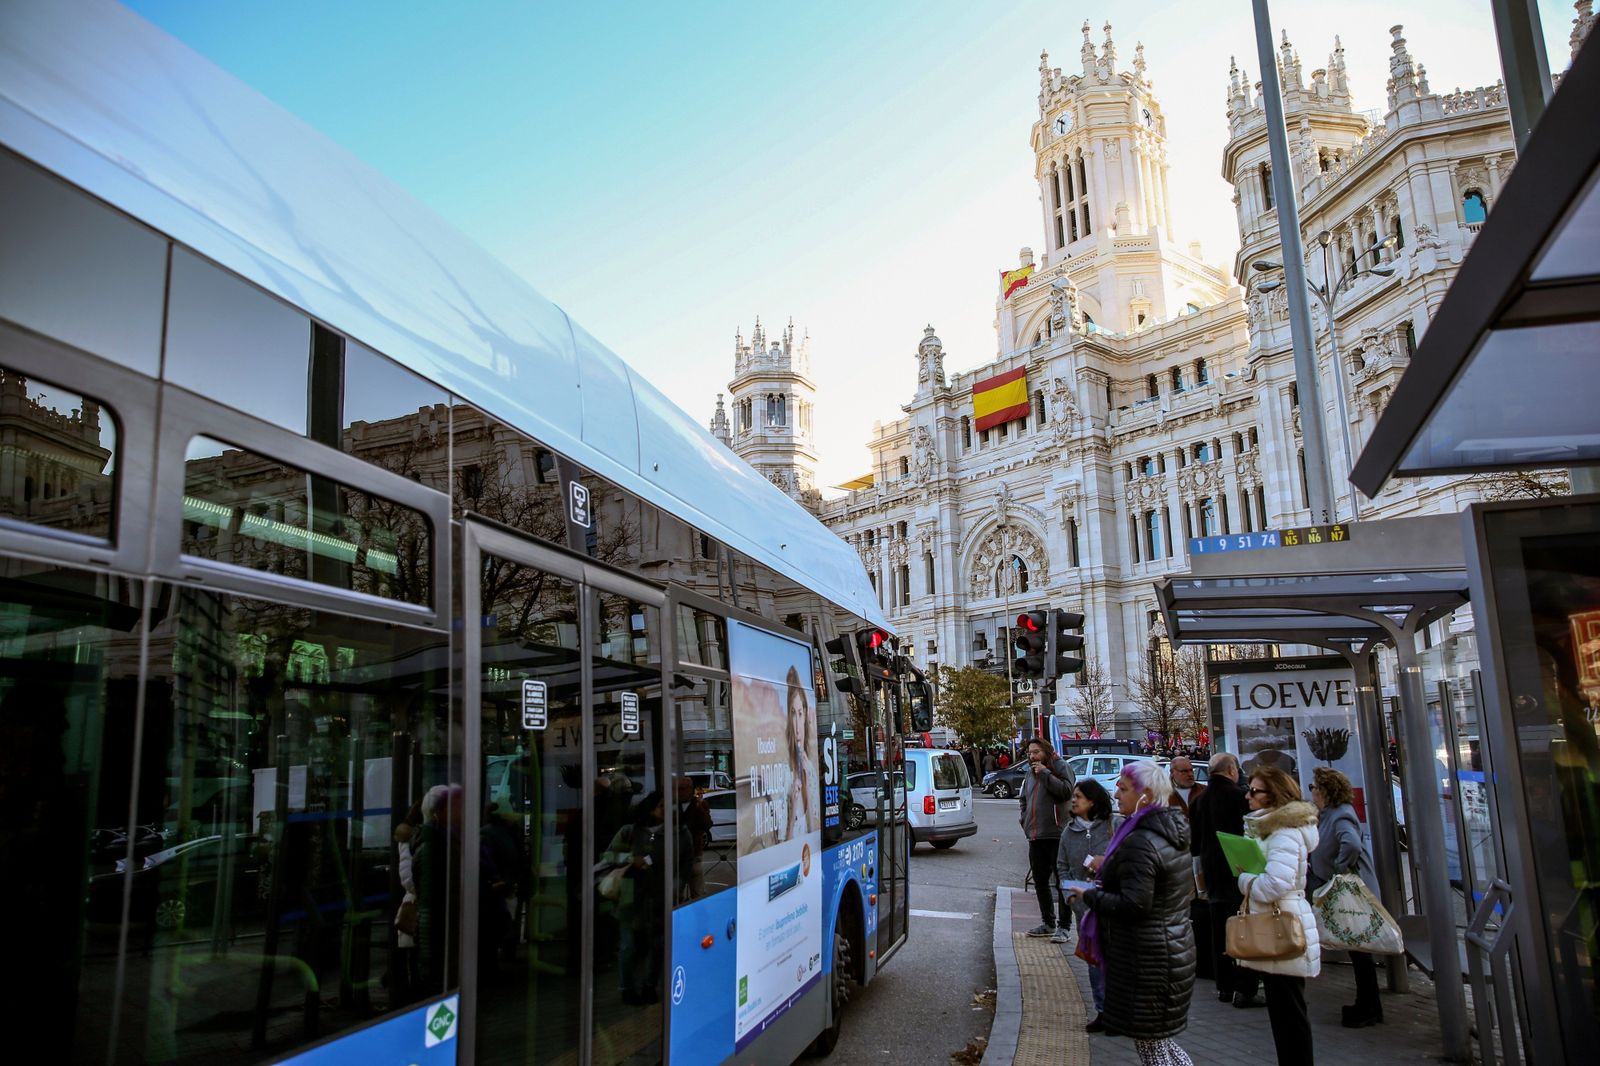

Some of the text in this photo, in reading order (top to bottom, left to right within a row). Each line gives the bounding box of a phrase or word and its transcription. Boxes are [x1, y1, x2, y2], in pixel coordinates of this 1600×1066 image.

[1198, 531, 1344, 552] 1 9 51 74 N5 N6 N7
[1232, 680, 1354, 710] LOEWE
[852, 841, 864, 862] 2173
[432, 1012, 451, 1031] GNC
